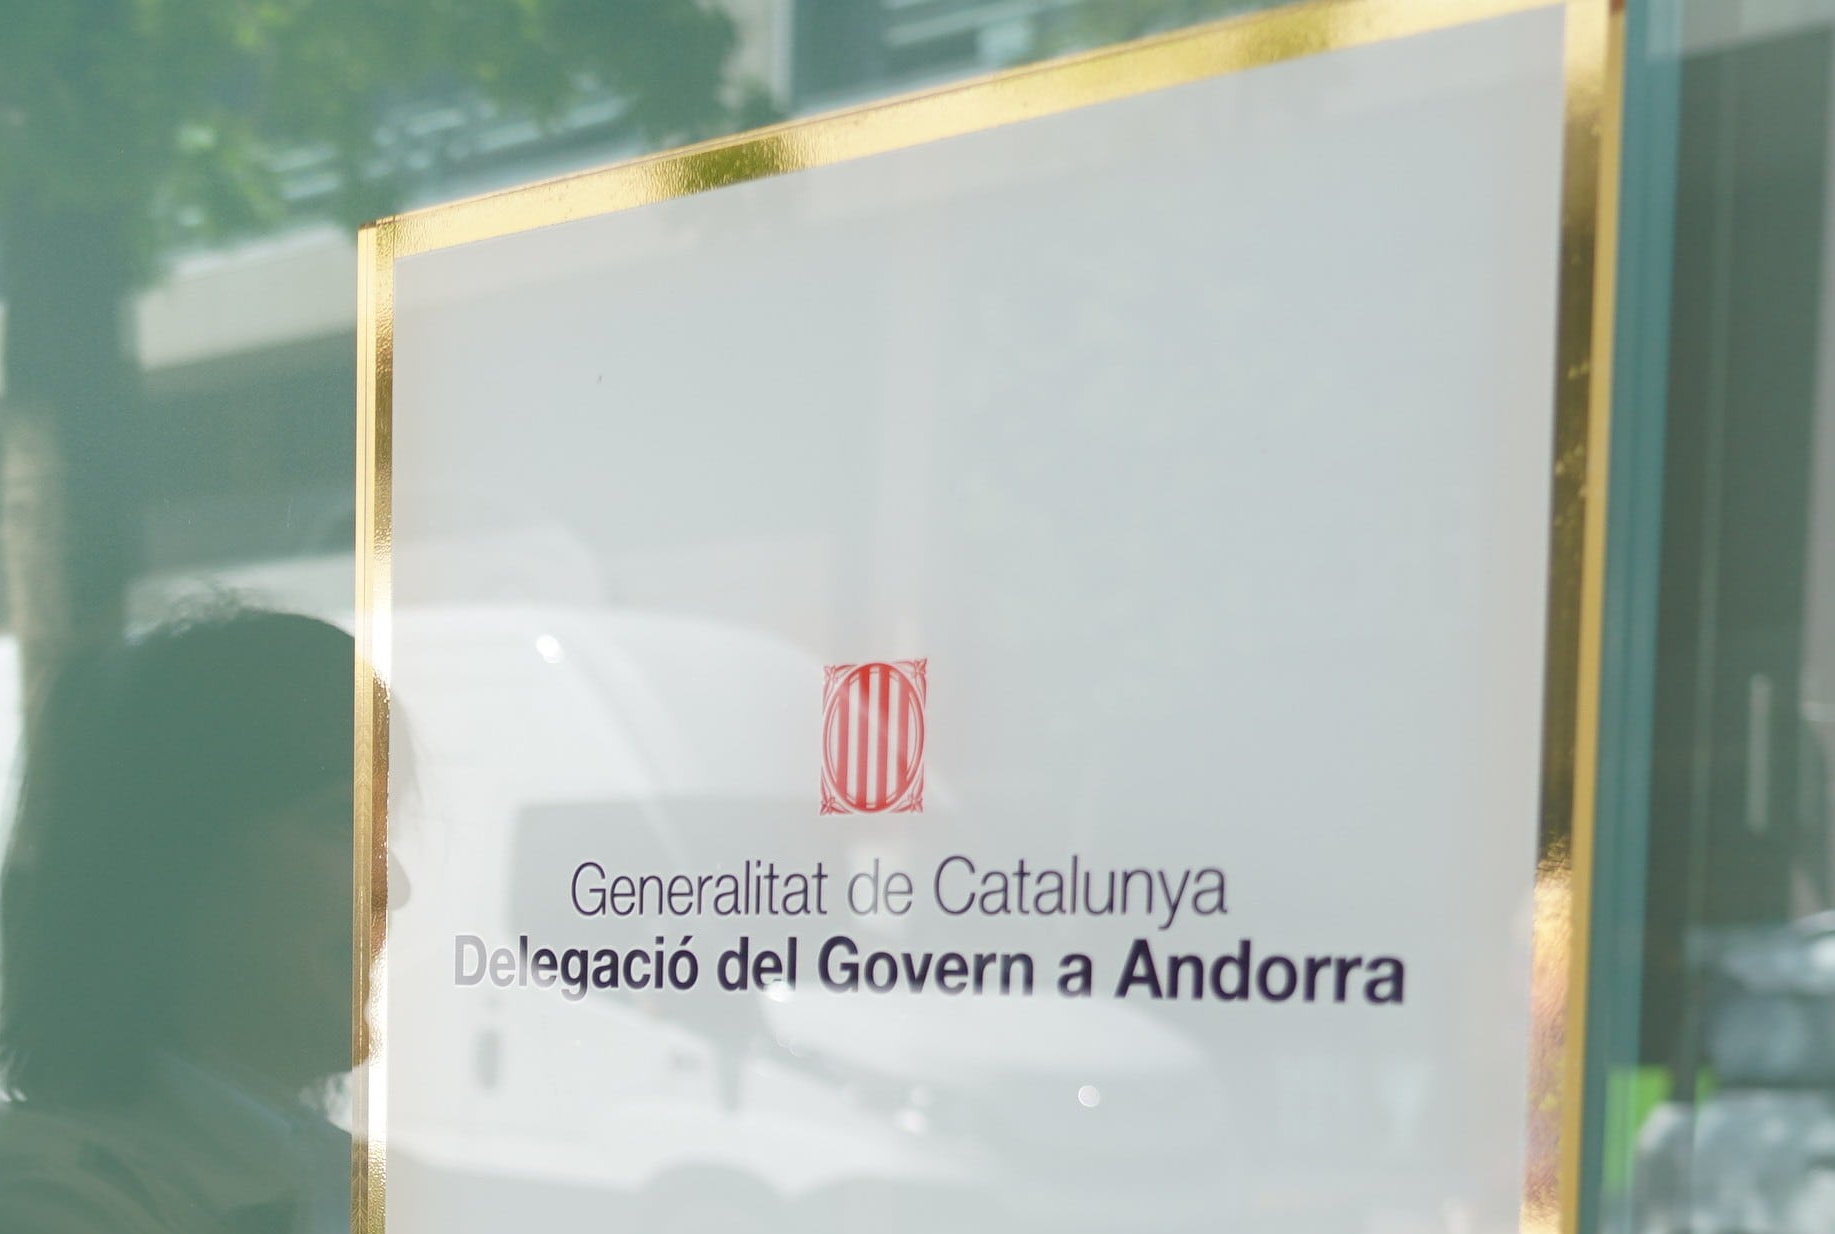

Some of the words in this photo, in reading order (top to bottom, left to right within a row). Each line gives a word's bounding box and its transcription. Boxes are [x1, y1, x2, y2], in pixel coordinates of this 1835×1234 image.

[570, 859, 828, 916] Generalitat
[846, 857, 914, 916] de
[932, 854, 1229, 931] Catalunya
[453, 934, 699, 1001] Delegació
[716, 936, 798, 993] del
[817, 935, 1034, 996] Govern
[1056, 952, 1093, 998] a
[1113, 938, 1405, 1005] Andorra
